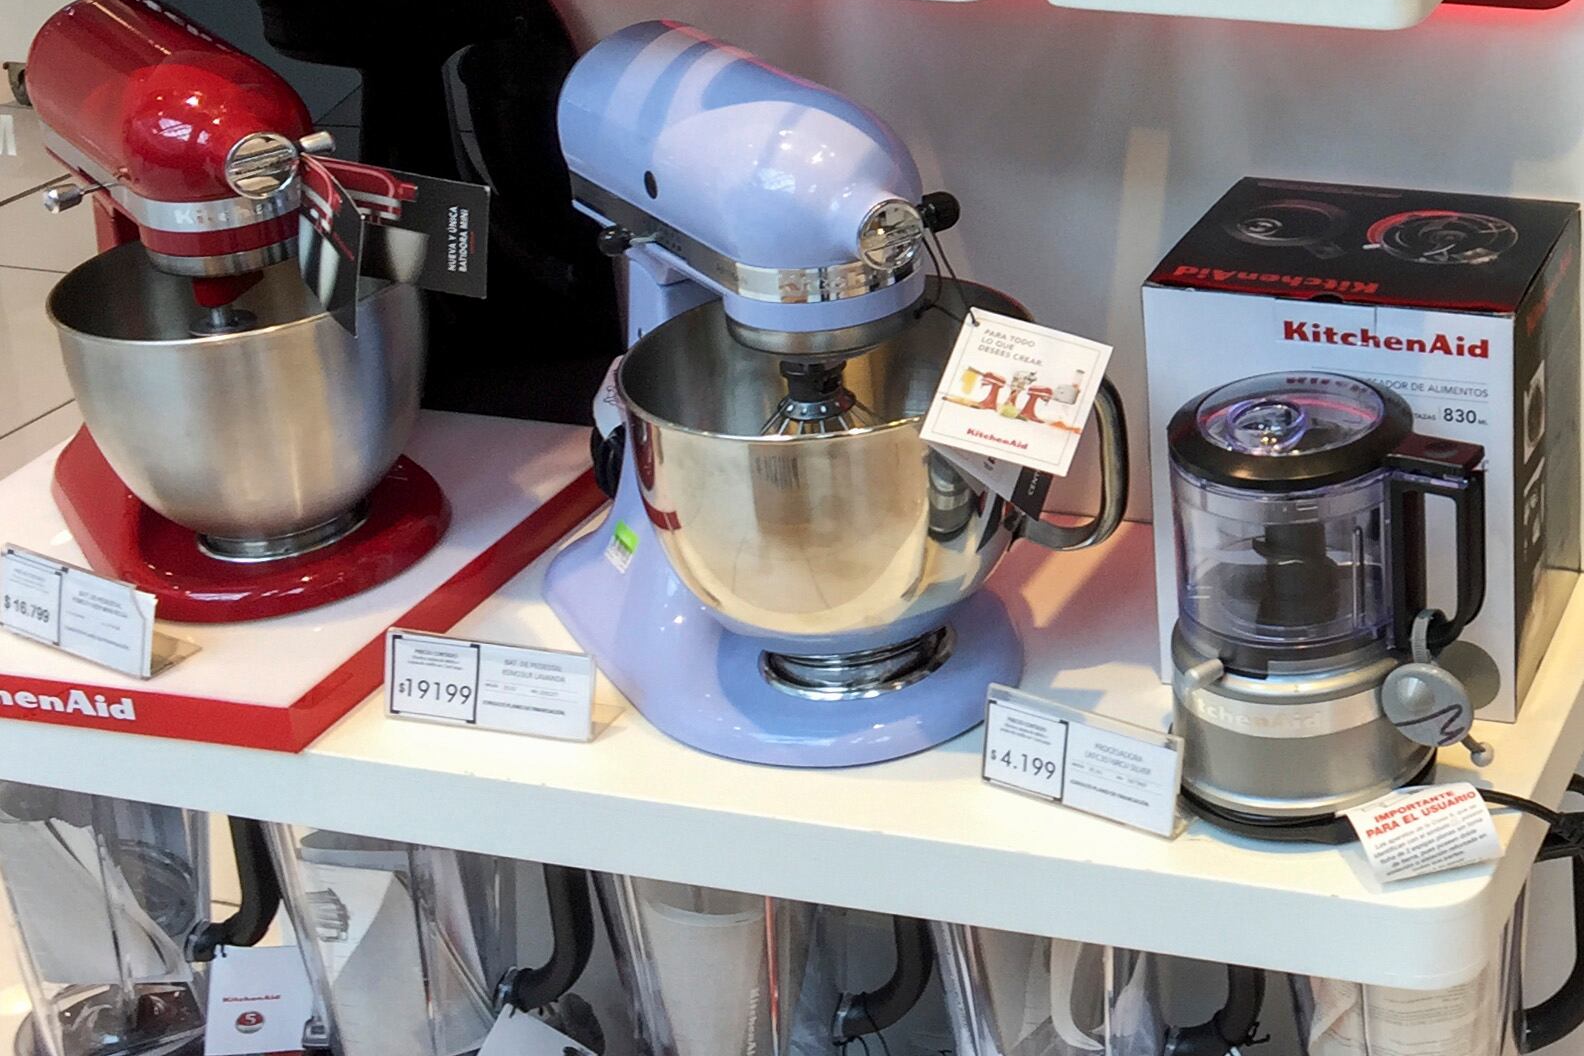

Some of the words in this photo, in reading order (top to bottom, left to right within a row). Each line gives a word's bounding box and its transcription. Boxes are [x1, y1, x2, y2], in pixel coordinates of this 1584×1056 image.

[459, 208, 470, 230] MINI
[447, 234, 457, 242] Y
[447, 243, 457, 272] NUEVA
[458, 231, 468, 273] BATIDORA
[1173, 265, 1382, 294] KitchenAid
[981, 337, 993, 345] LO
[983, 329, 1008, 342] PARA
[1283, 320, 1490, 359] KitchenAid
[977, 344, 1012, 359] DESEES
[1411, 382, 1425, 392] DE
[1427, 384, 1489, 399] ALIMENTOS
[1443, 407, 1478, 425] 830
[966, 427, 1030, 451] KitchenAid
[1365, 820, 1400, 839] PARA
[1402, 812, 1419, 824] EL
[1421, 790, 1477, 817] USUARIO
[1374, 790, 1456, 823] IMPORTANTE
